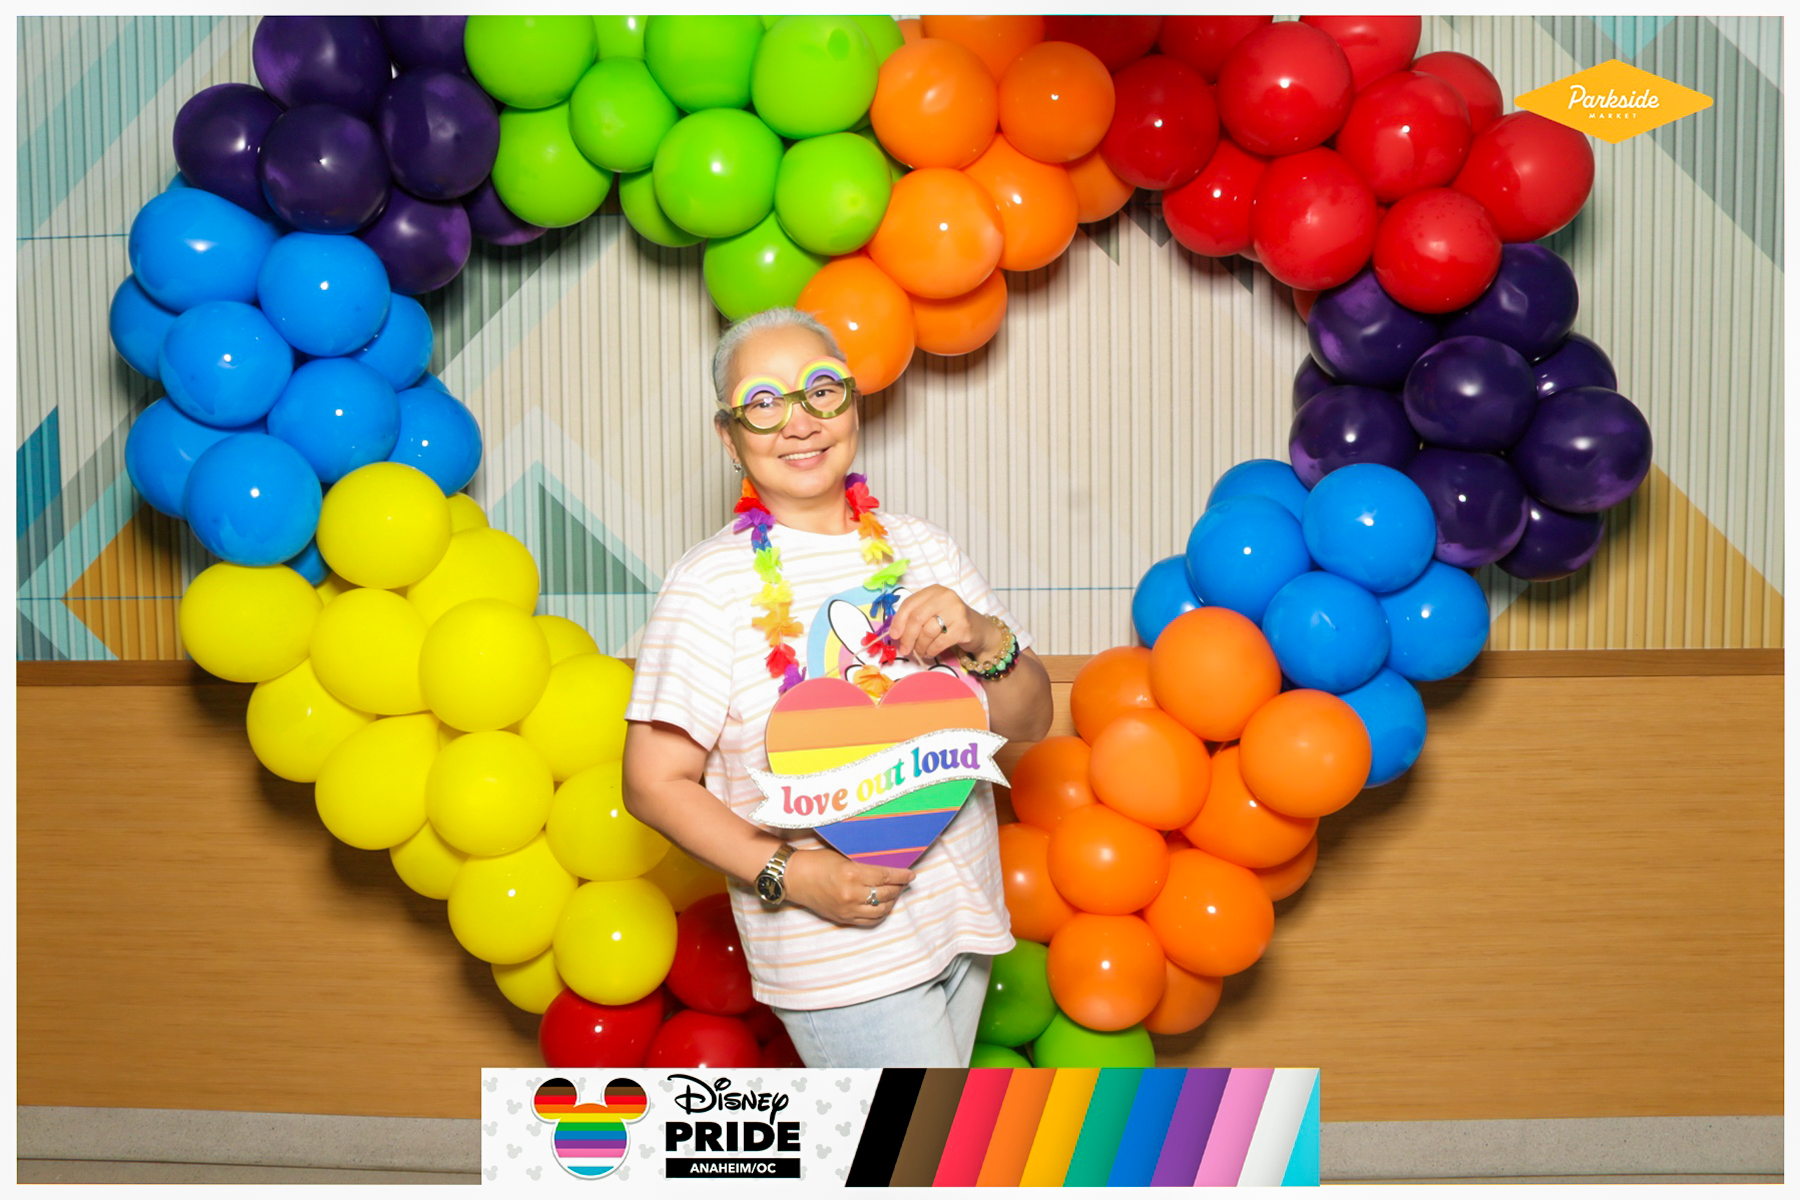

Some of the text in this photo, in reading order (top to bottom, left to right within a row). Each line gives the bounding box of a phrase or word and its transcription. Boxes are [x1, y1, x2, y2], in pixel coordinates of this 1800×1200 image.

[781, 742, 981, 816] love out loud
